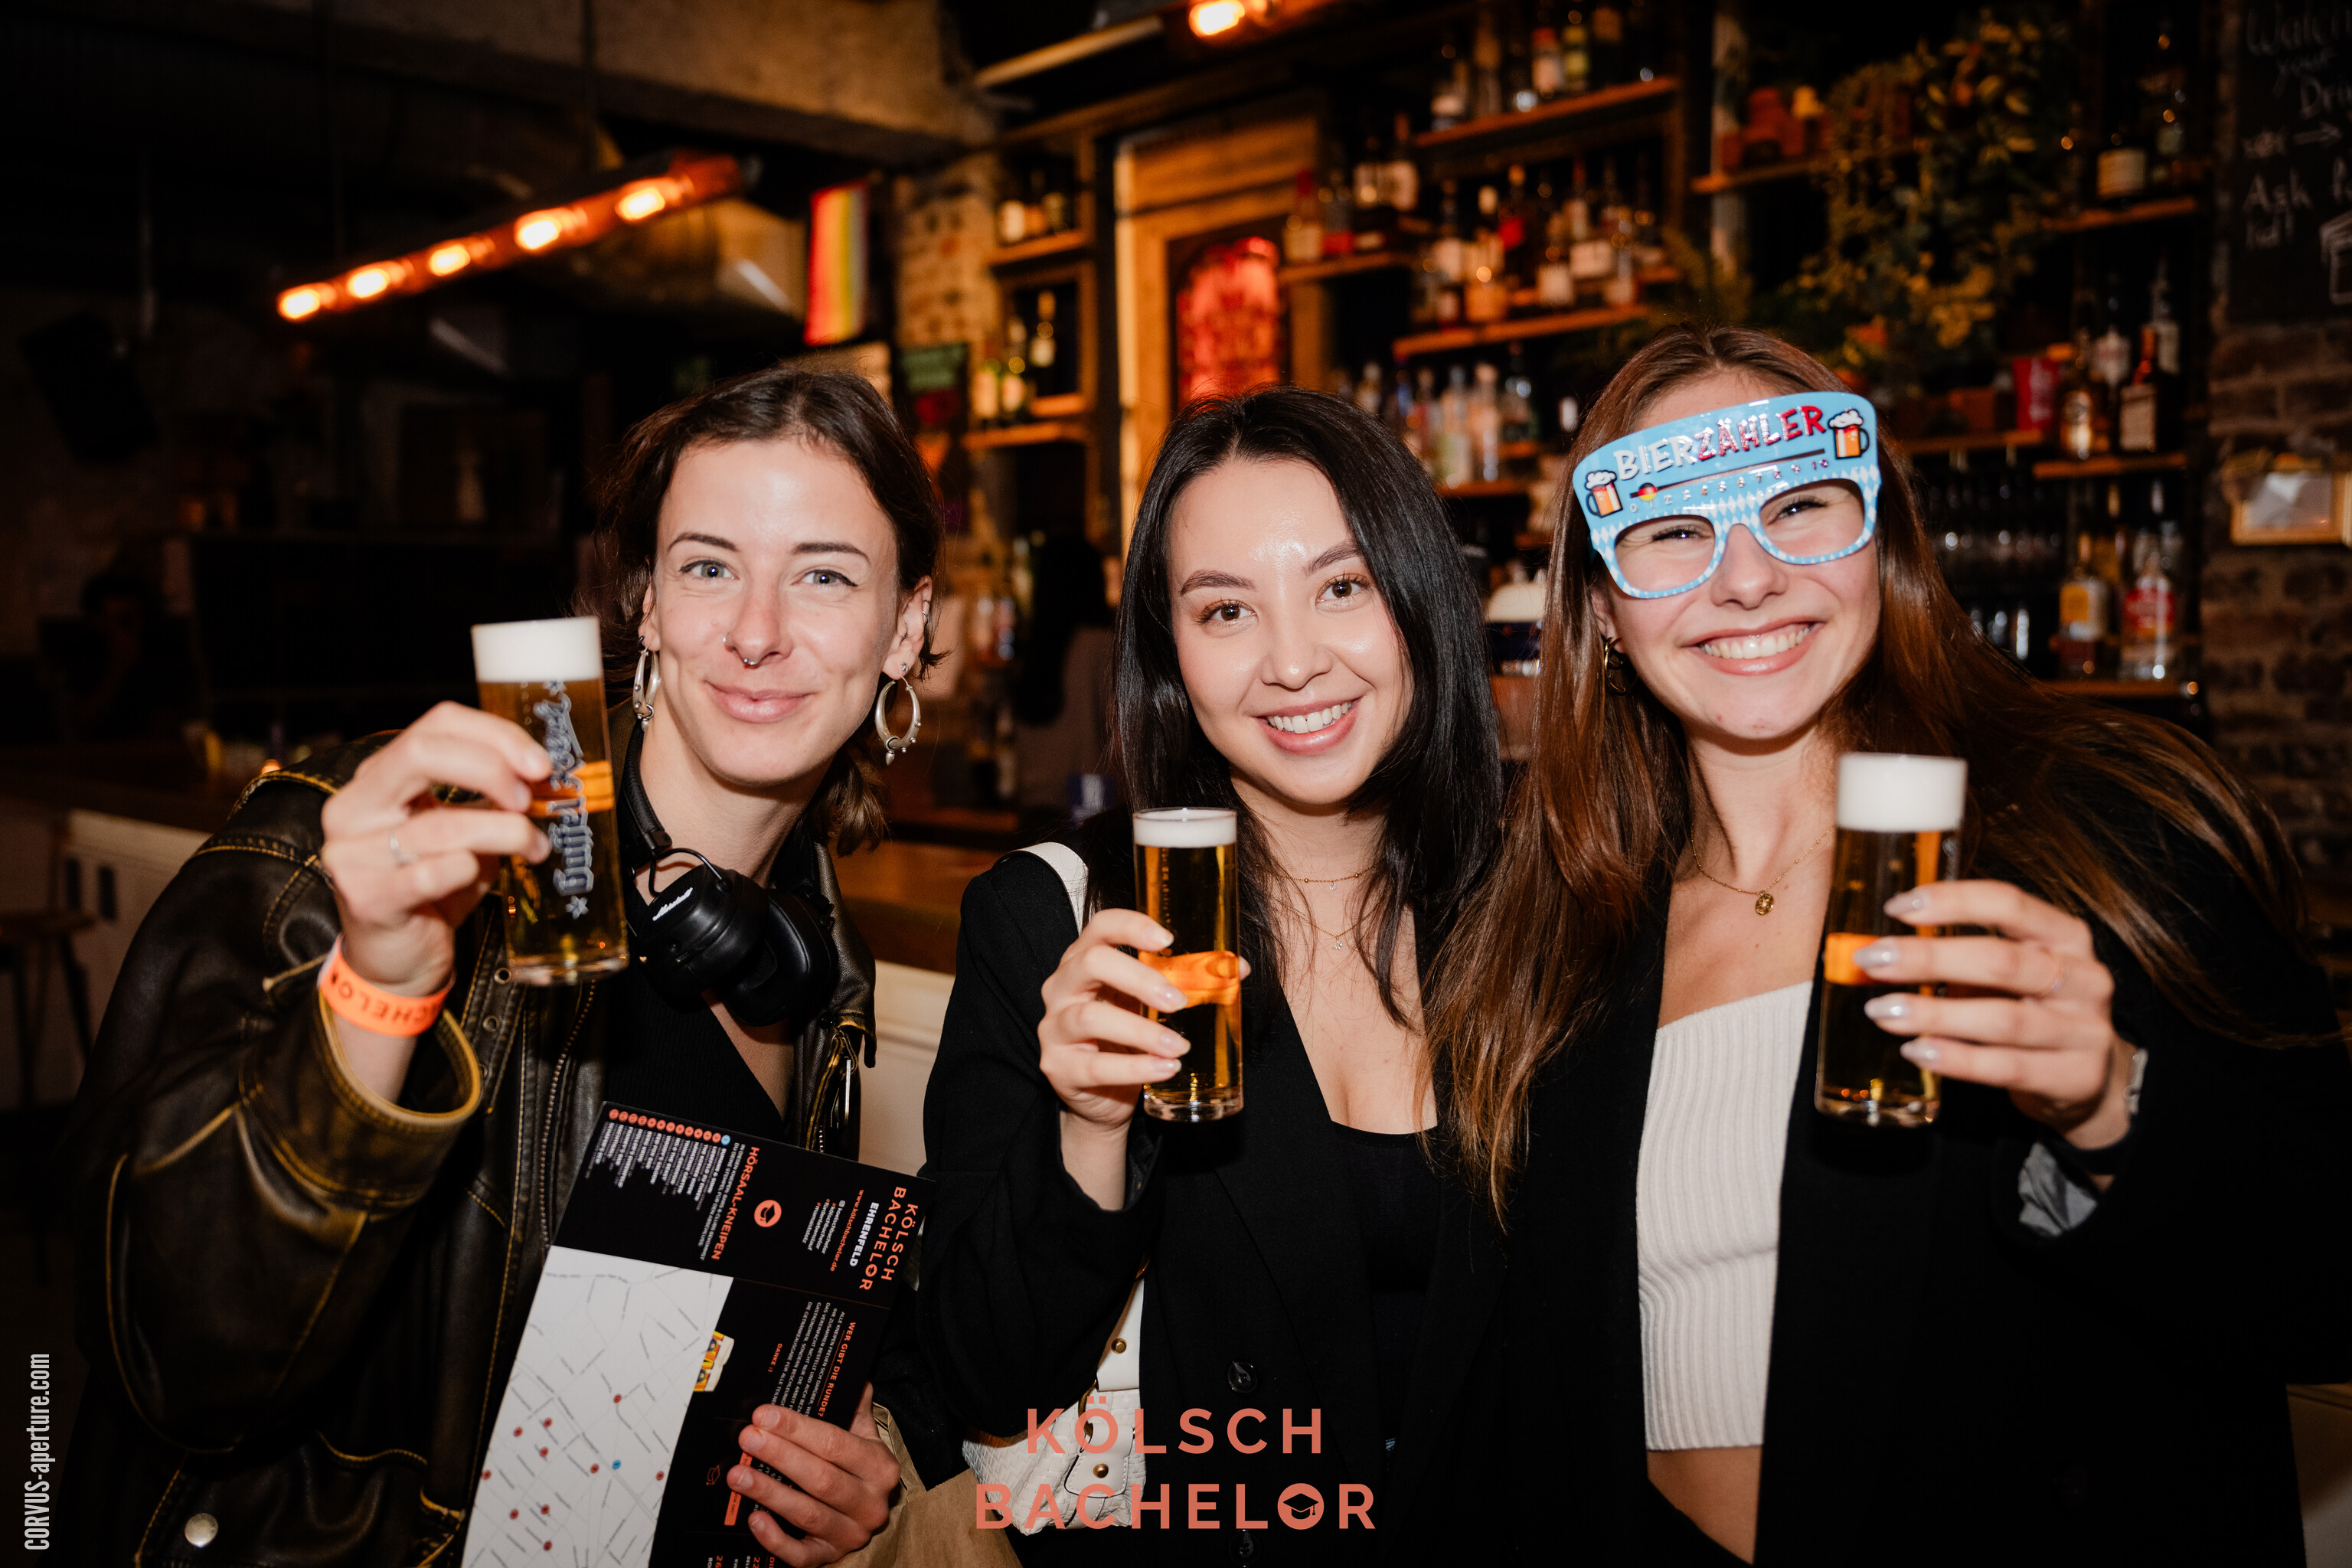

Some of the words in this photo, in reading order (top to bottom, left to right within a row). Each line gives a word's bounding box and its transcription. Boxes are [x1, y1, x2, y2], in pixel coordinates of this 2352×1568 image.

[1612, 404, 1828, 481] BIERZÄHLER
[711, 1147, 760, 1259] HÖRSAAL-KNEIPEN
[831, 1190, 864, 1271] www.kölschbachelor.de
[850, 1202, 879, 1266] EHRENFELD
[859, 1187, 906, 1289] BACHELOR
[881, 1204, 918, 1280] KÖLSCH
[812, 1314, 826, 1347] VEREINFACHT
[821, 1318, 834, 1347] ZUSAMMEN
[830, 1325, 840, 1346] KNEIPEN
[844, 1322, 856, 1341] WER
[771, 1344, 782, 1365] DANKE
[794, 1344, 806, 1367] SONDERN
[805, 1348, 814, 1364] NICHT
[812, 1348, 823, 1370] BESTELLT
[822, 1347, 832, 1366] FREUEN
[837, 1344, 848, 1364] GIBT
[831, 1366, 840, 1380] DIE
[791, 1386, 799, 1403] ARBEIT
[818, 1383, 834, 1416] RUNDE?
